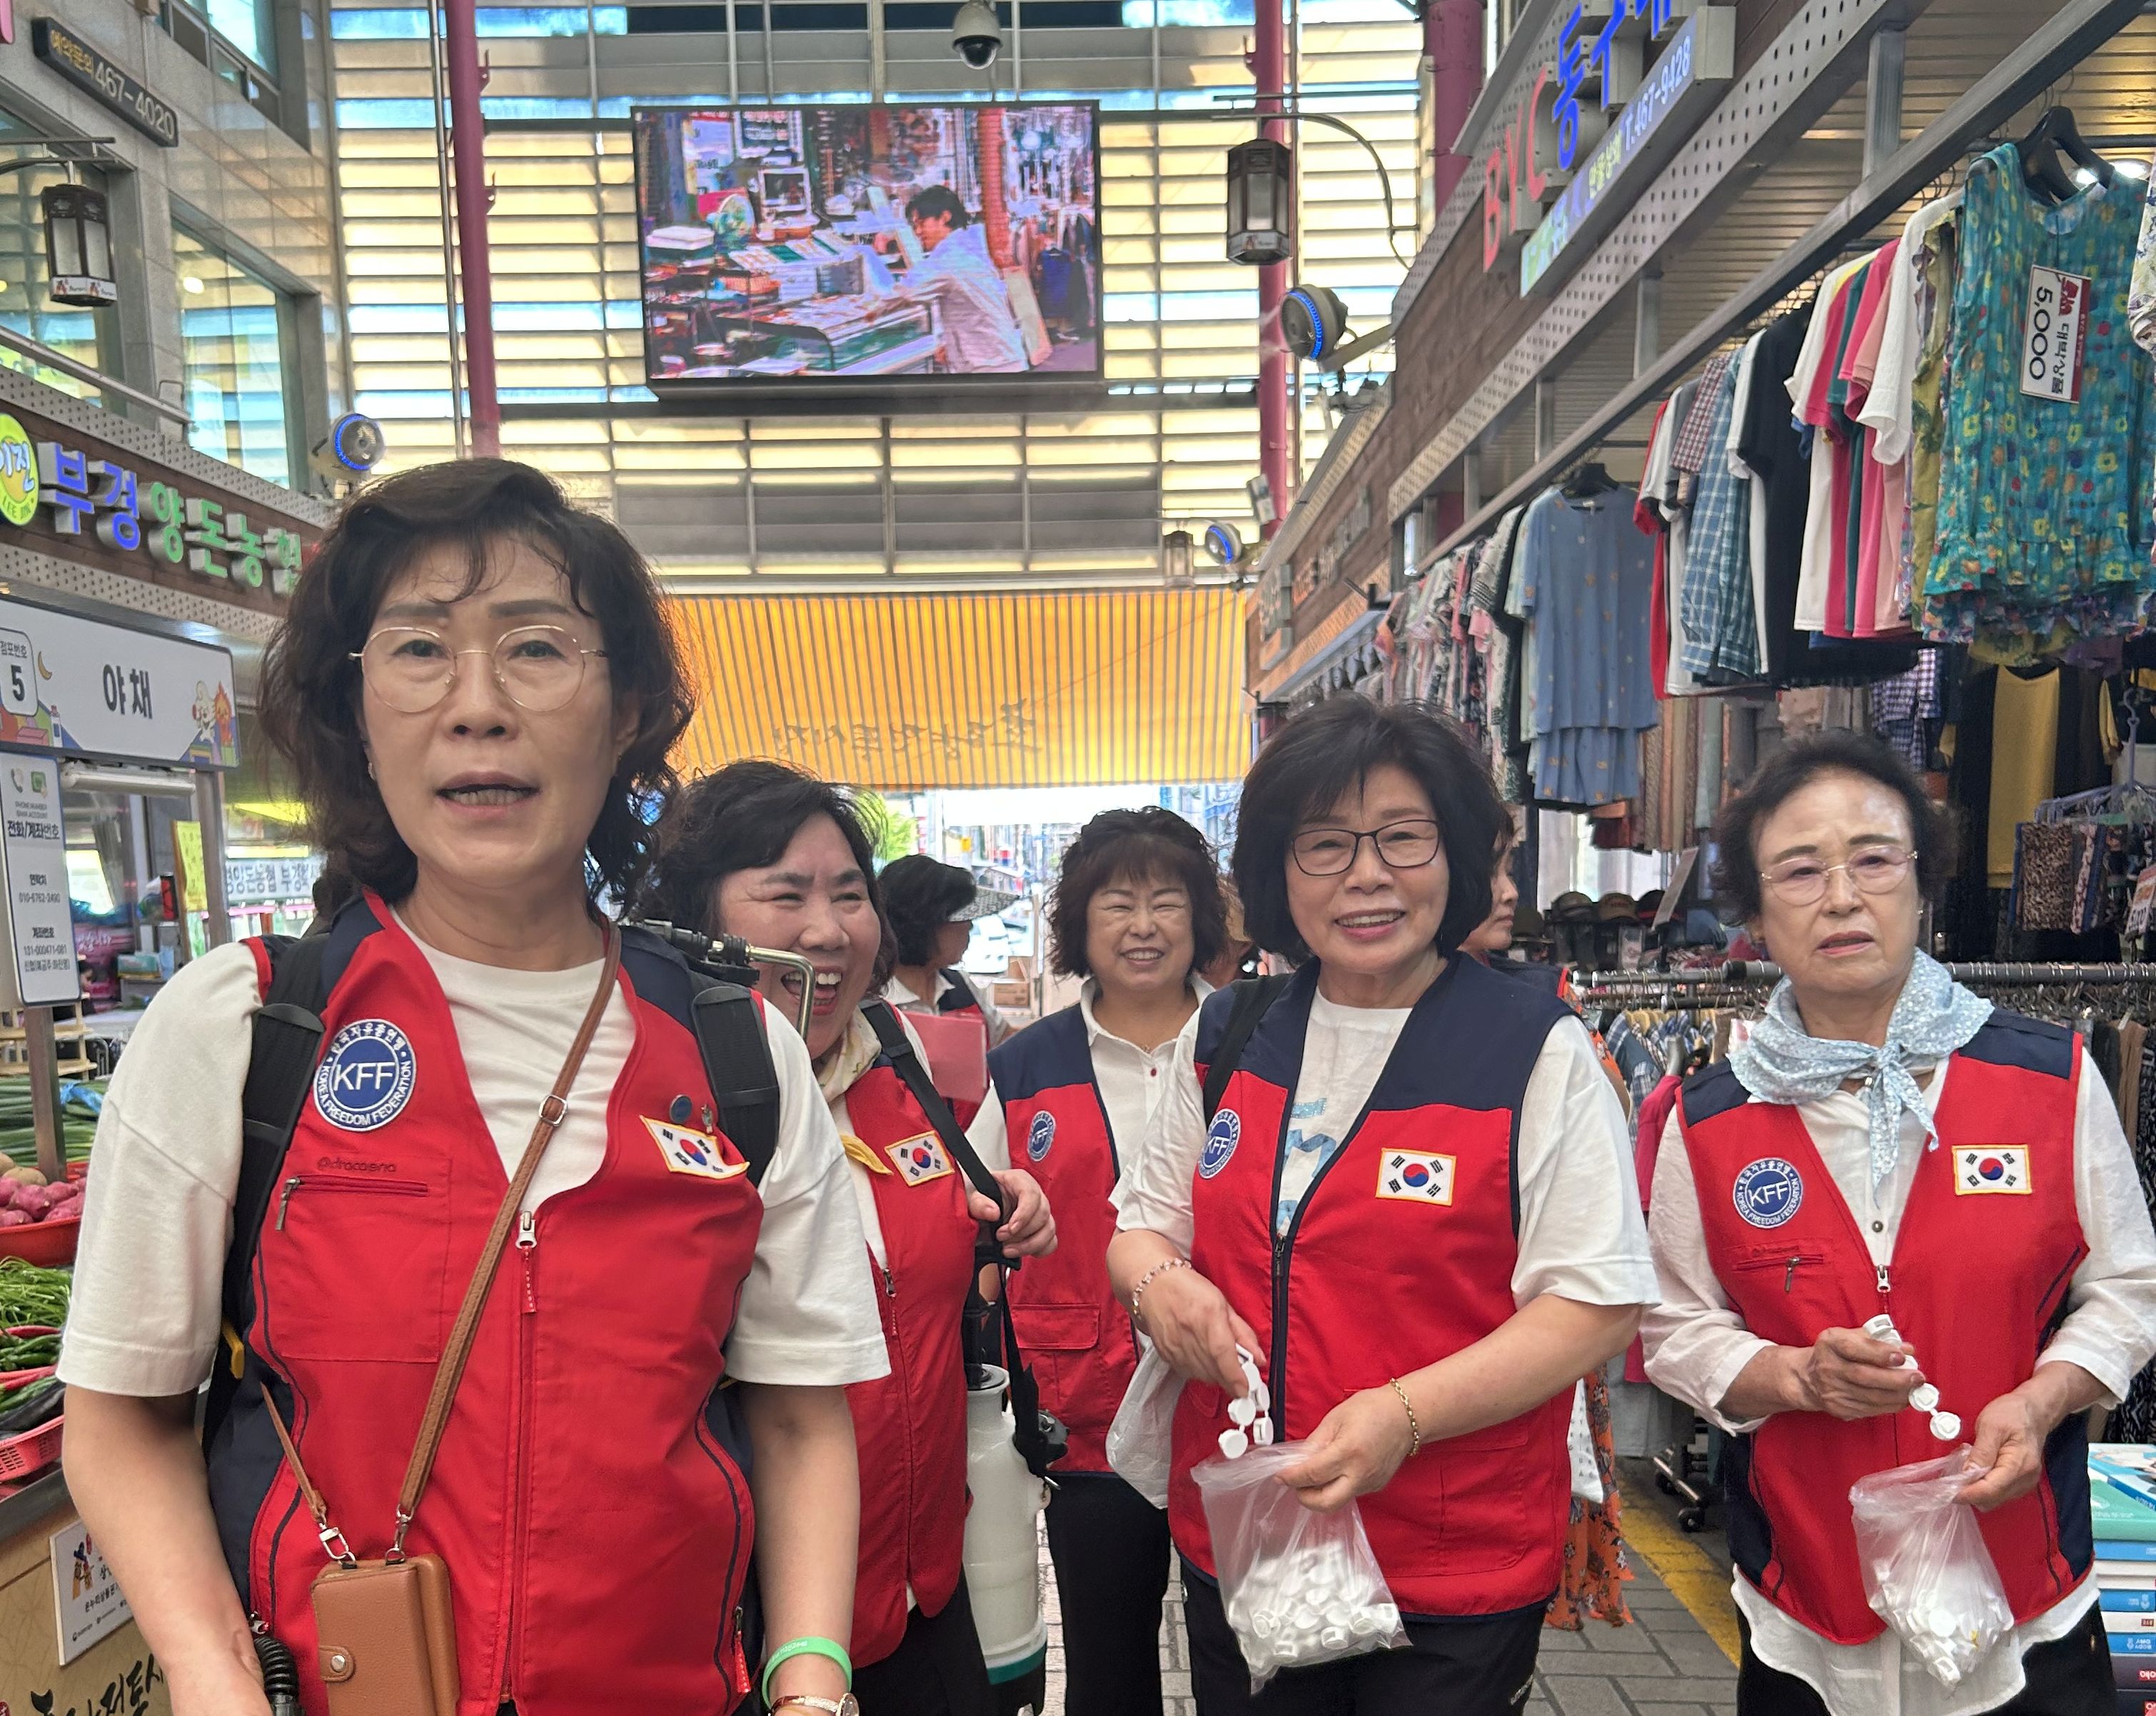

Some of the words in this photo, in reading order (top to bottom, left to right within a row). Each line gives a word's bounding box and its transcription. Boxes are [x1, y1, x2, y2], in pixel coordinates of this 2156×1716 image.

[95, 61, 175, 139] 467-4020
[1483, 64, 1548, 273] BYC
[2030, 286, 2053, 381] 5,000
[2052, 323, 2069, 394] 대박상품
[11, 664, 26, 701] 5
[103, 663, 153, 720] 야채
[7, 820, 60, 840] 전화/계좌번호
[331, 1022, 408, 1055] 한국자유총연맹
[318, 1065, 331, 1107] KOREA
[333, 1062, 396, 1091] KFF
[372, 1060, 412, 1123] FEDERATION
[322, 1100, 371, 1125] FREEDOM
[1736, 1191, 1751, 1215] KOREA
[1747, 1213, 1781, 1225] FREEDOM
[1780, 1177, 1800, 1219] FEDERATION
[1748, 1180, 1788, 1207] KFF
